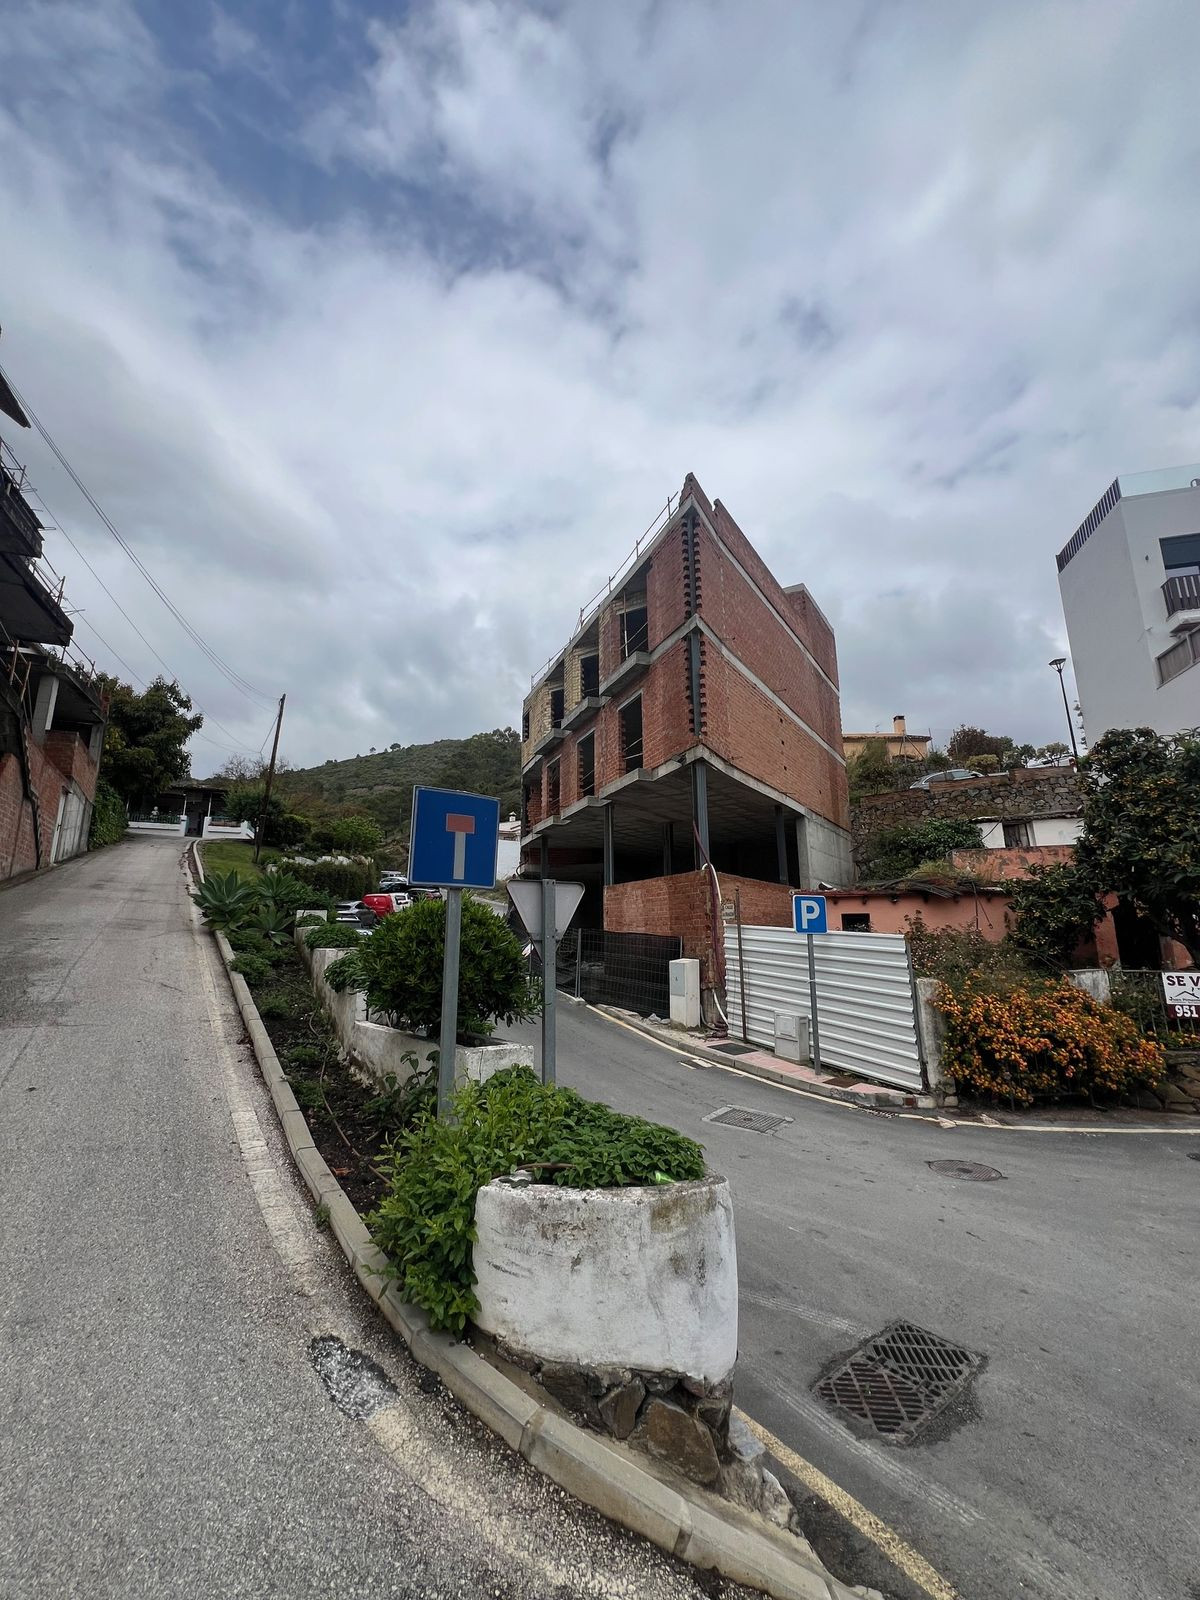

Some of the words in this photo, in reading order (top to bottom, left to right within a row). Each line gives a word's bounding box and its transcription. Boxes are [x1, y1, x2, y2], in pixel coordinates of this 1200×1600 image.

[801, 900, 820, 929] P
[1166, 975, 1186, 987] SE
[1175, 1004, 1199, 1018] 951
